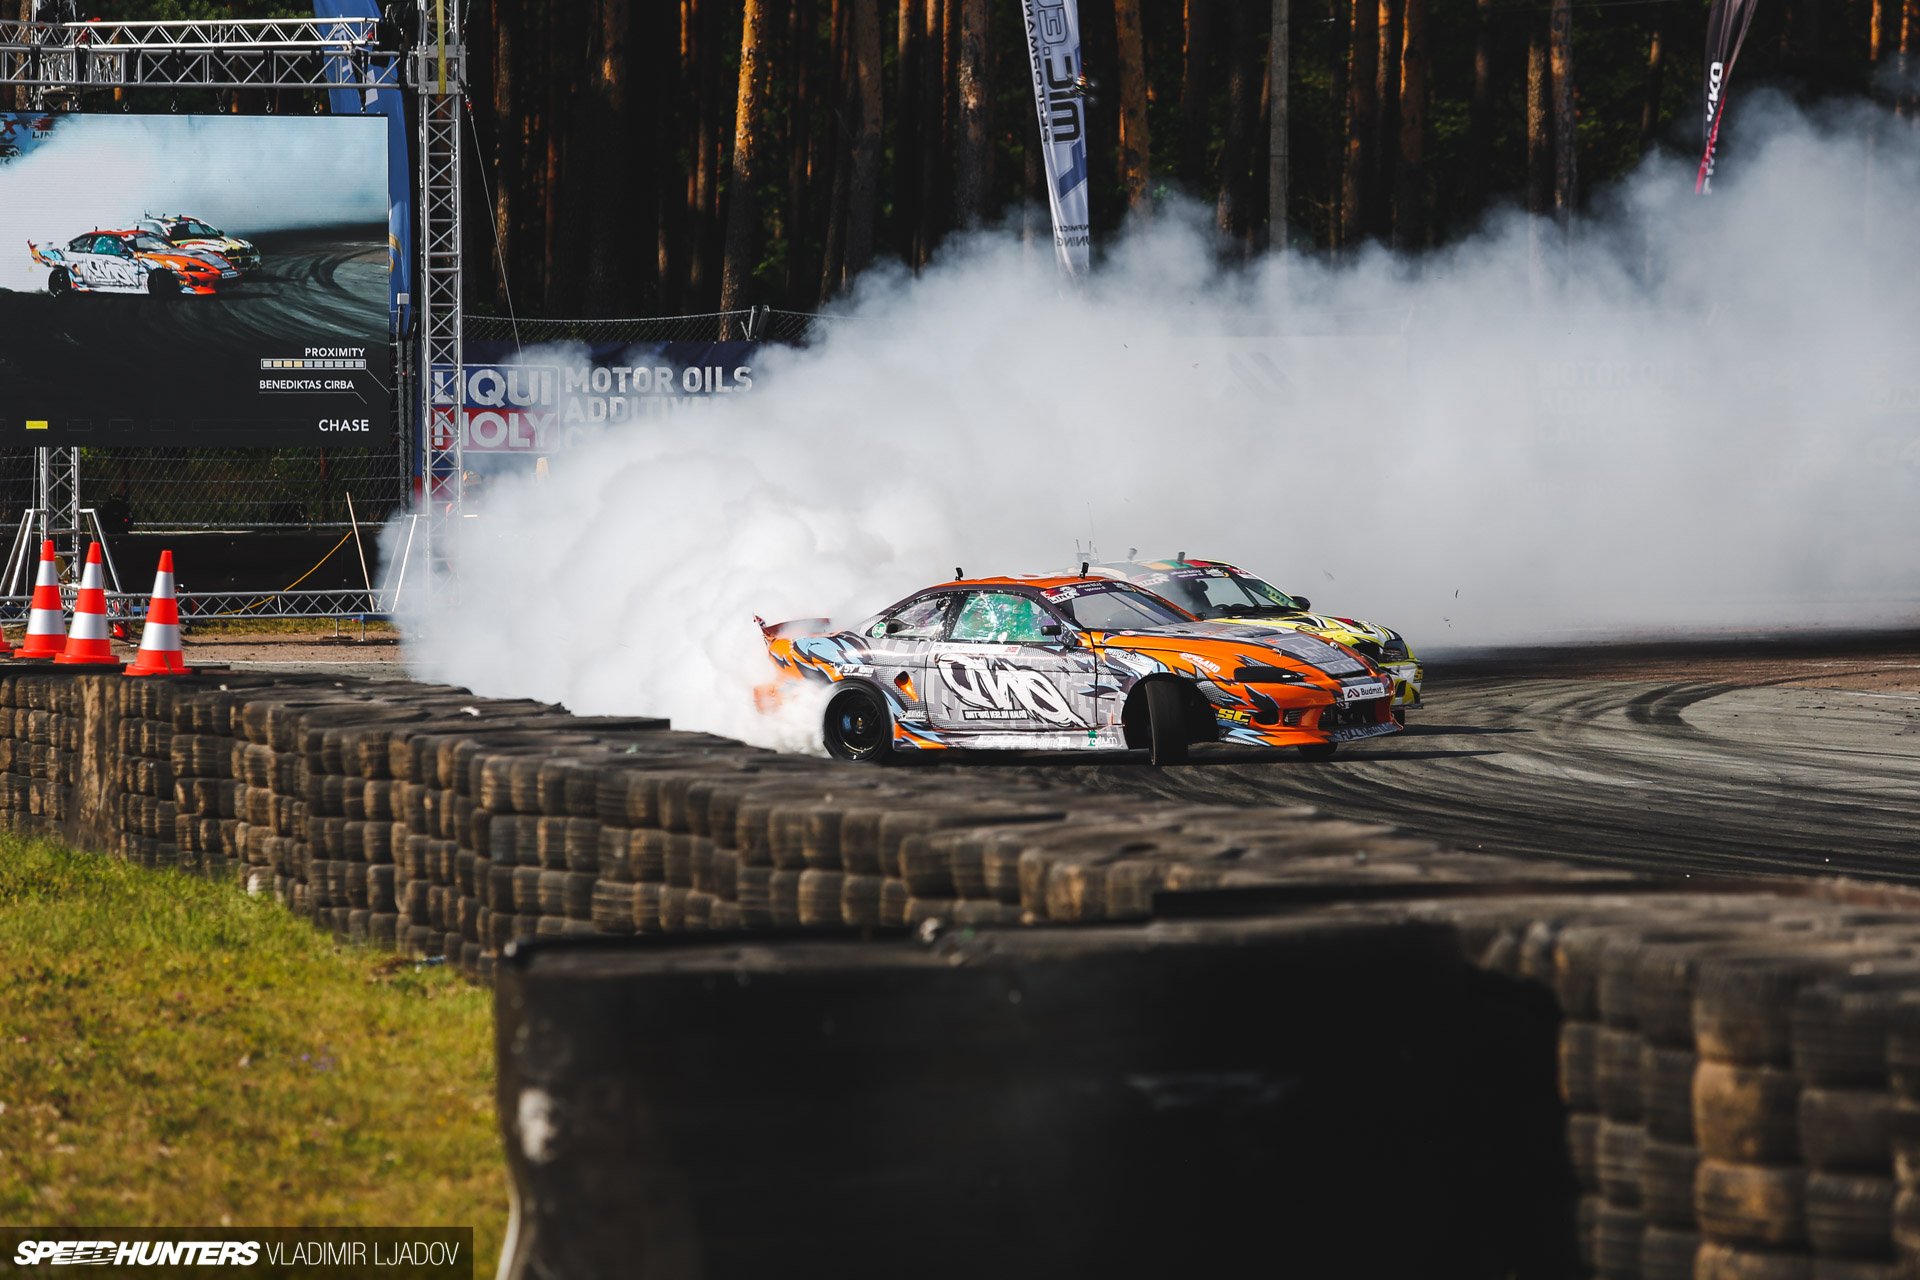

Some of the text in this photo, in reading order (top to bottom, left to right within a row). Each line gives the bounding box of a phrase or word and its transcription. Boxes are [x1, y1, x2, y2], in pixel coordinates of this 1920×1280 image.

[305, 348, 365, 357] PROXIMITY
[260, 380, 354, 389] BENEDIKTAS CIRBA
[435, 369, 551, 408] LIQUI
[565, 366, 753, 393] MOTOR OILS
[319, 419, 369, 431] CHASE
[435, 412, 556, 448] MOLY
